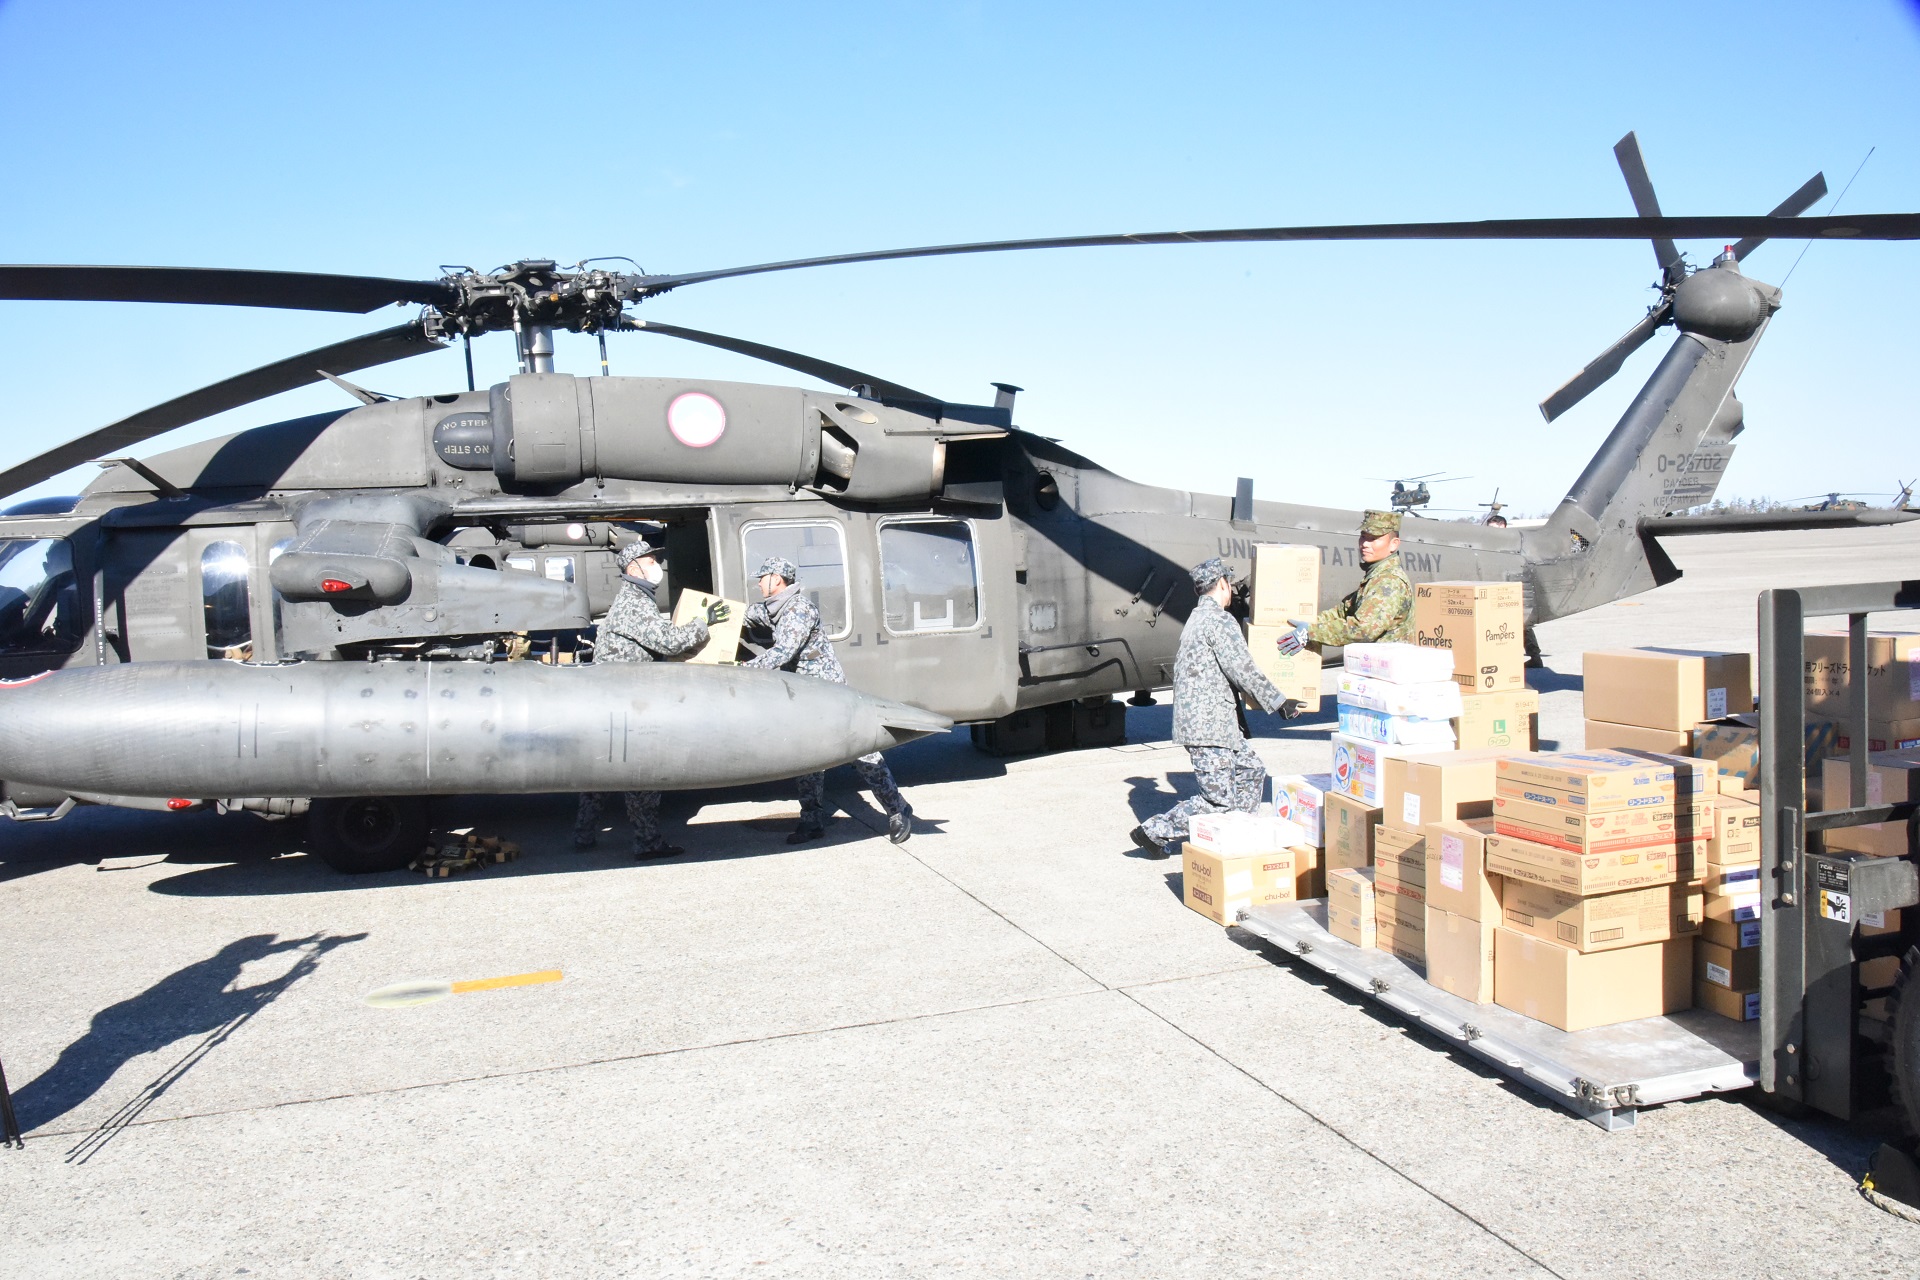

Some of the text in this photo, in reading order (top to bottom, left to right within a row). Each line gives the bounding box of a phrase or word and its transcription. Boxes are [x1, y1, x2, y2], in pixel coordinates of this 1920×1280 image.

[442, 419, 488, 431] NO STEP
[444, 445, 490, 454] NO STEP
[1418, 587, 1432, 598] P&G
[1448, 608, 1473, 616] 80760099
[98, 630, 103, 638] DO
[1485, 630, 1515, 642] Pampers
[1418, 630, 1453, 649] Pampers
[1264, 891, 1290, 900] chu-bo!
